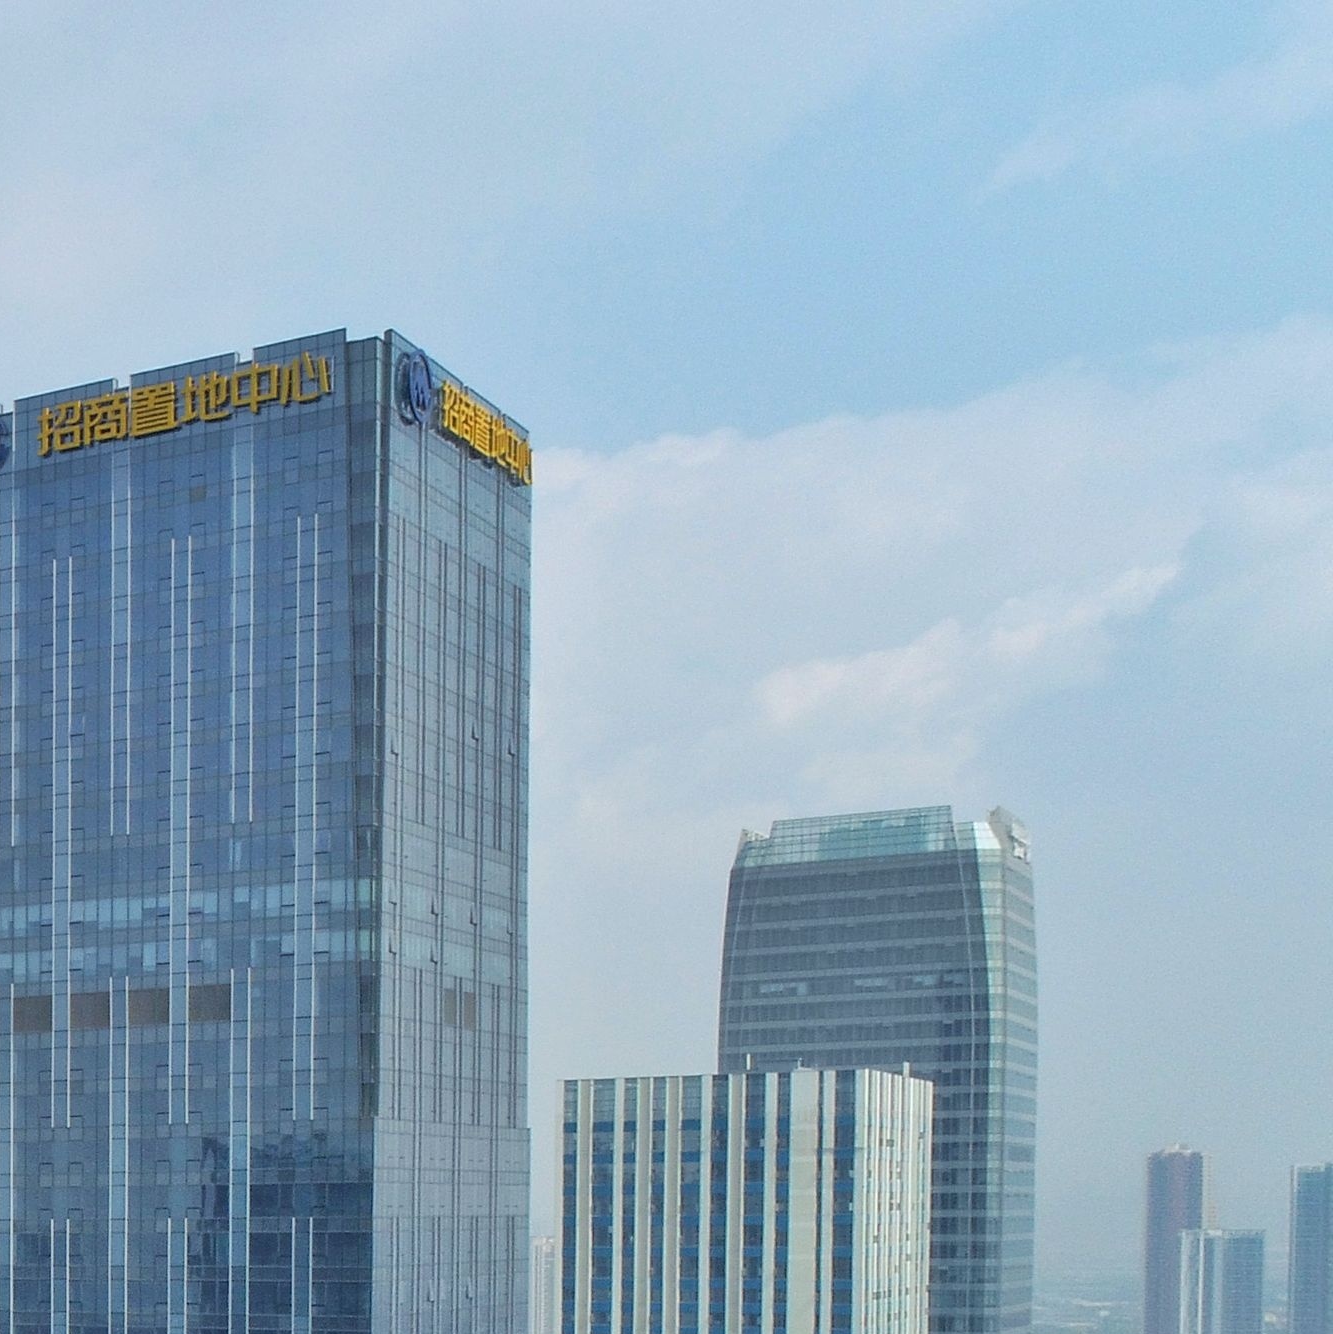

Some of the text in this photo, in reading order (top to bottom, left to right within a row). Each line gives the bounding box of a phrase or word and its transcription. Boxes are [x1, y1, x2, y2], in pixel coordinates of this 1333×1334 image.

[37, 352, 332, 457] 招商置地中心
[443, 380, 533, 486] 招商置地中心
